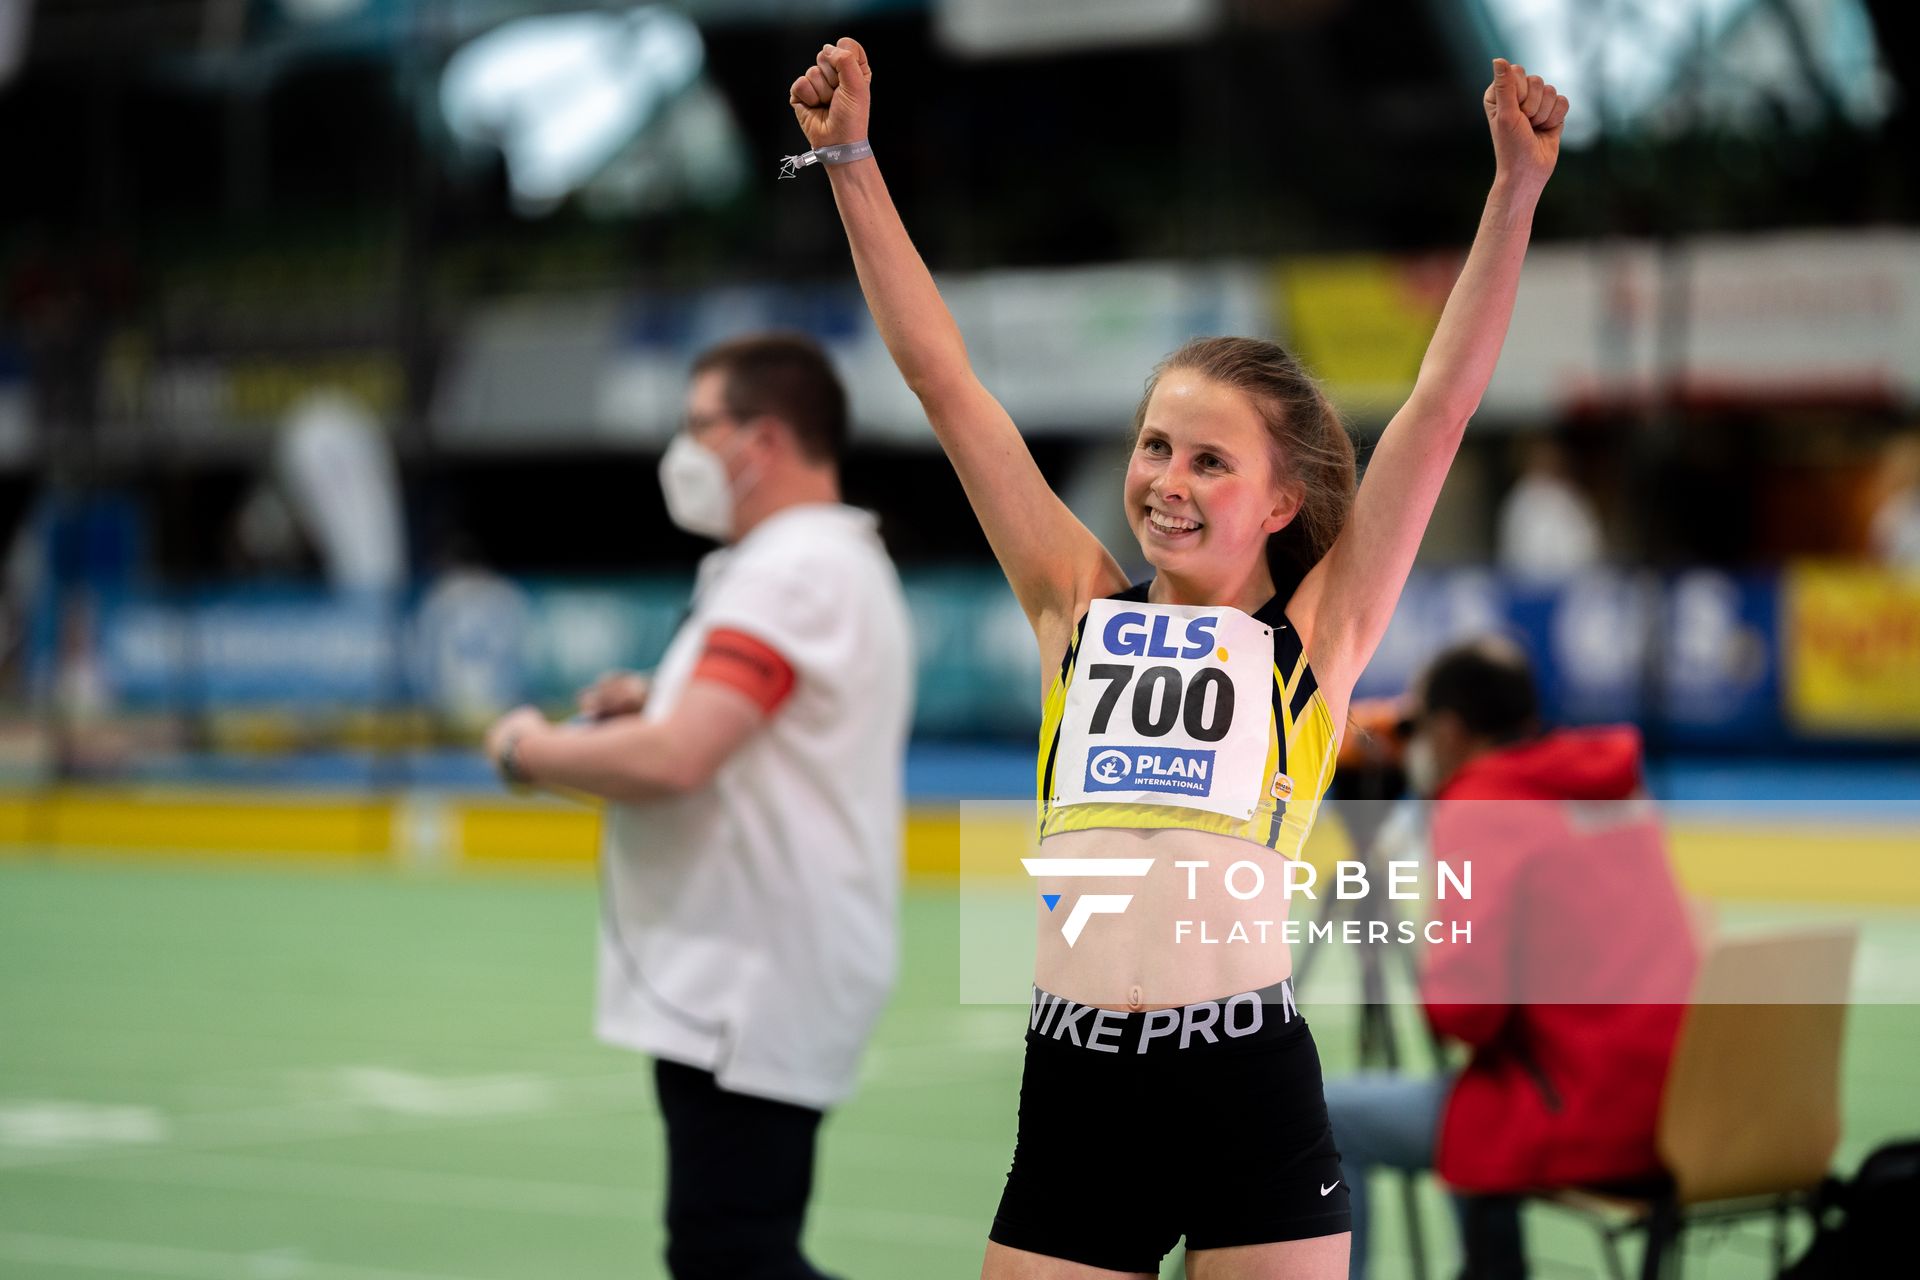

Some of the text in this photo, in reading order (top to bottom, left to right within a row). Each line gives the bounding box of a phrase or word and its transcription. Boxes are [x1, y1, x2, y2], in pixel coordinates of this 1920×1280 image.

[1088, 663, 1235, 742] 700
[1134, 778, 1204, 790] INTERNATIONAL
[1136, 755, 1208, 780] PLAN
[1137, 991, 1262, 1054] PRO
